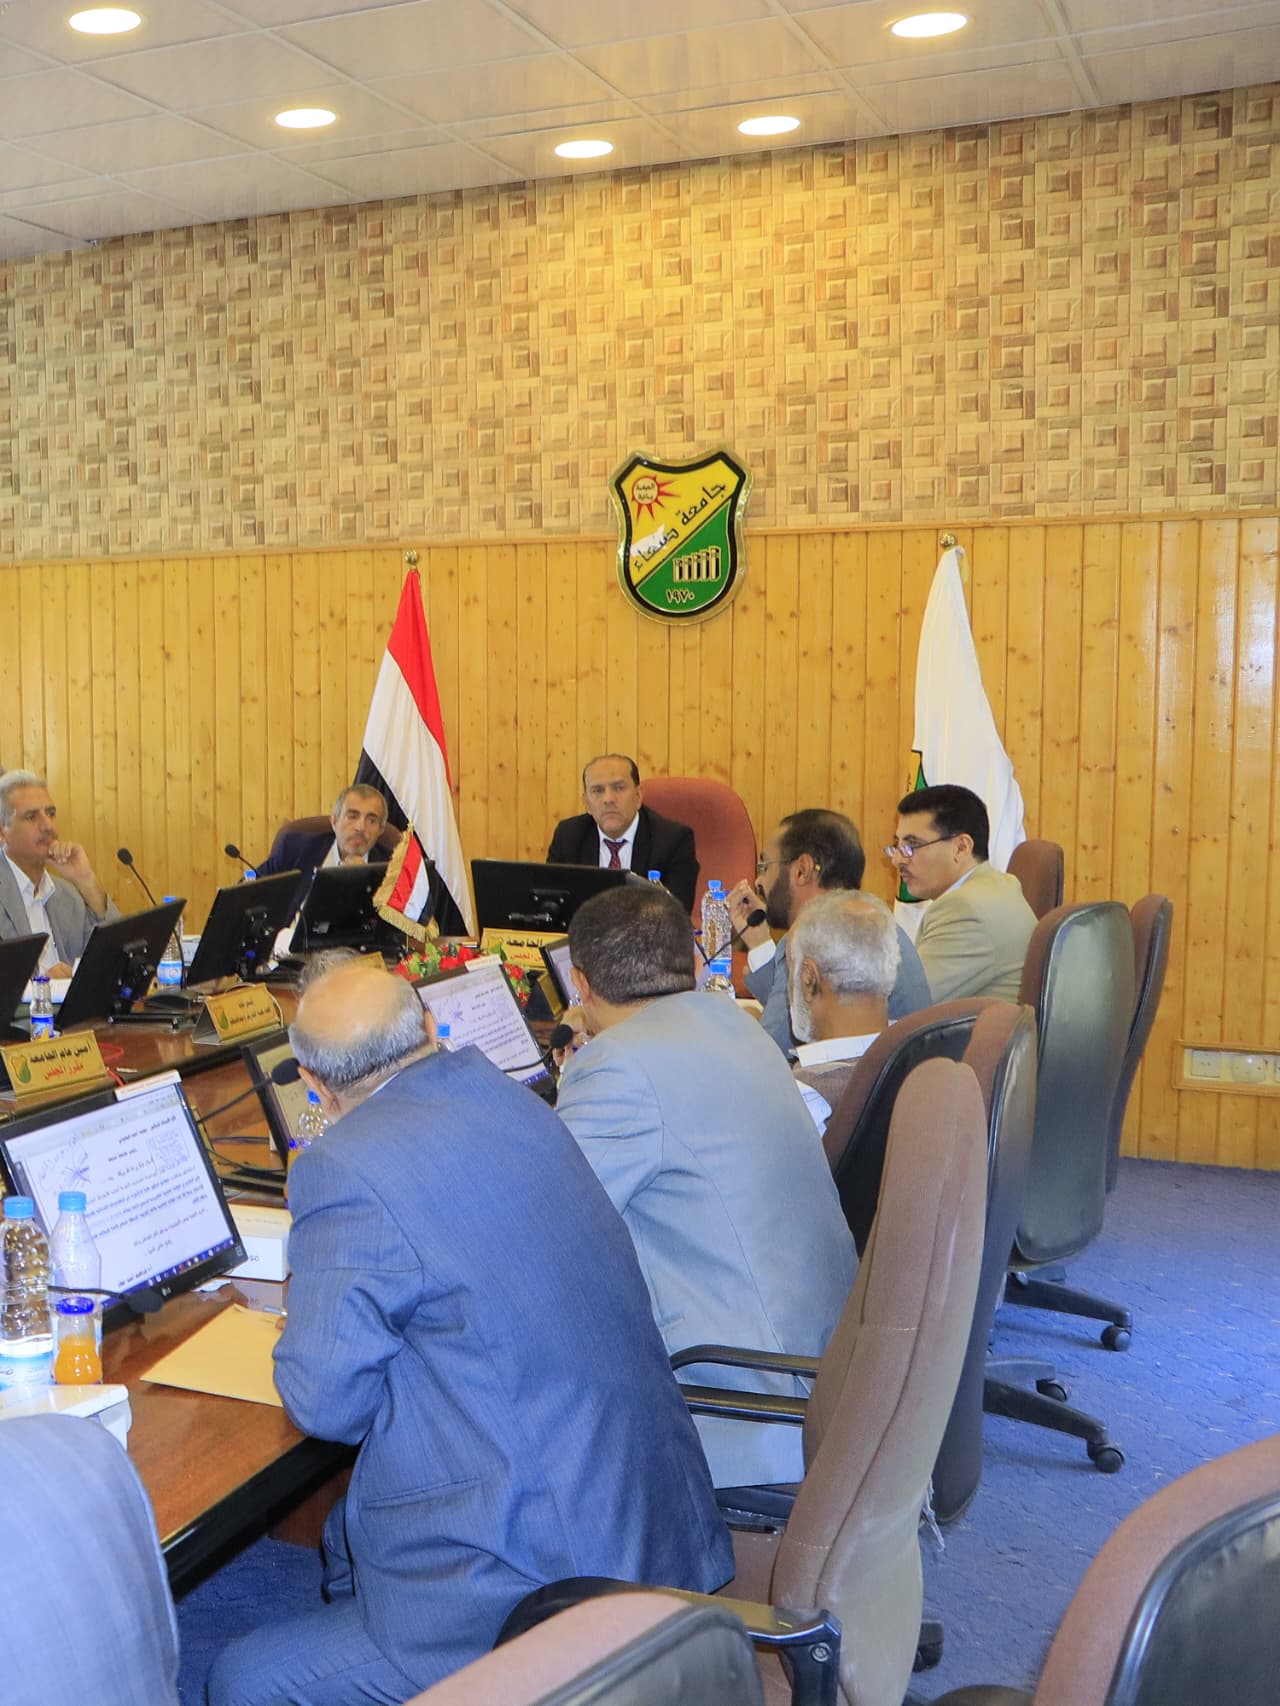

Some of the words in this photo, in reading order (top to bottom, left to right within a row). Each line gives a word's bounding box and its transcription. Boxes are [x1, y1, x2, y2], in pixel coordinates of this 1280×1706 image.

[675, 483, 727, 526] جامعة
[634, 527, 680, 573] صنعاء
[666, 588, 696, 604] ١٩٧٠
